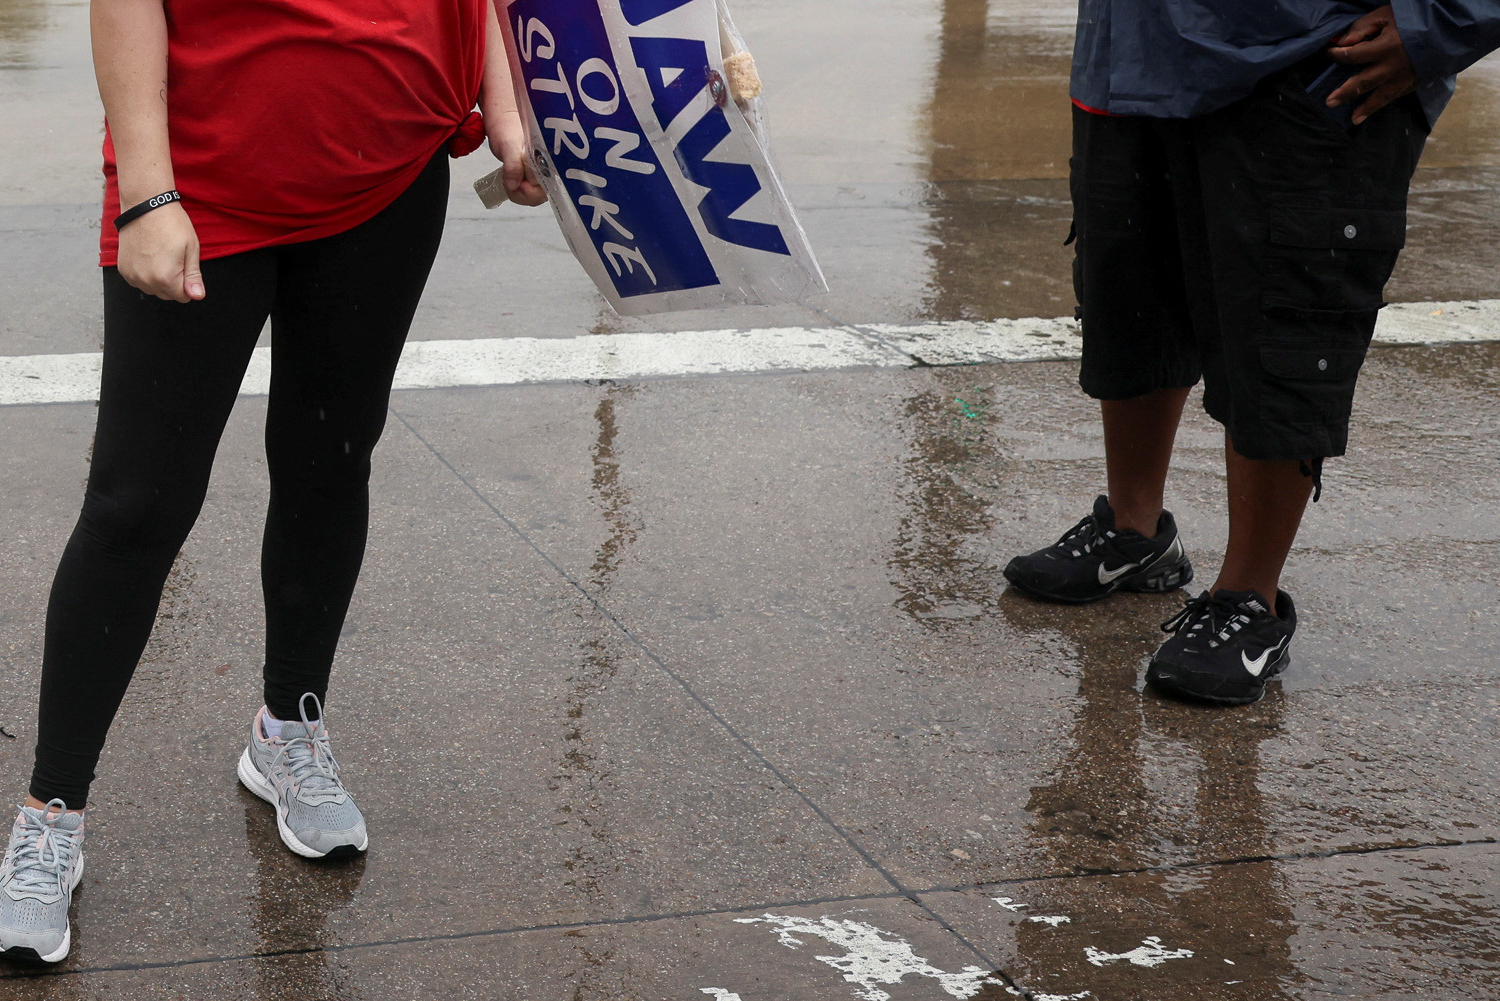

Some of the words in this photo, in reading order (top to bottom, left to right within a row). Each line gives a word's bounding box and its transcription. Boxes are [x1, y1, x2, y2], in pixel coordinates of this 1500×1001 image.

[517, 14, 657, 286] STRIKE
[575, 57, 656, 176] ON
[149, 193, 172, 208] GOD
